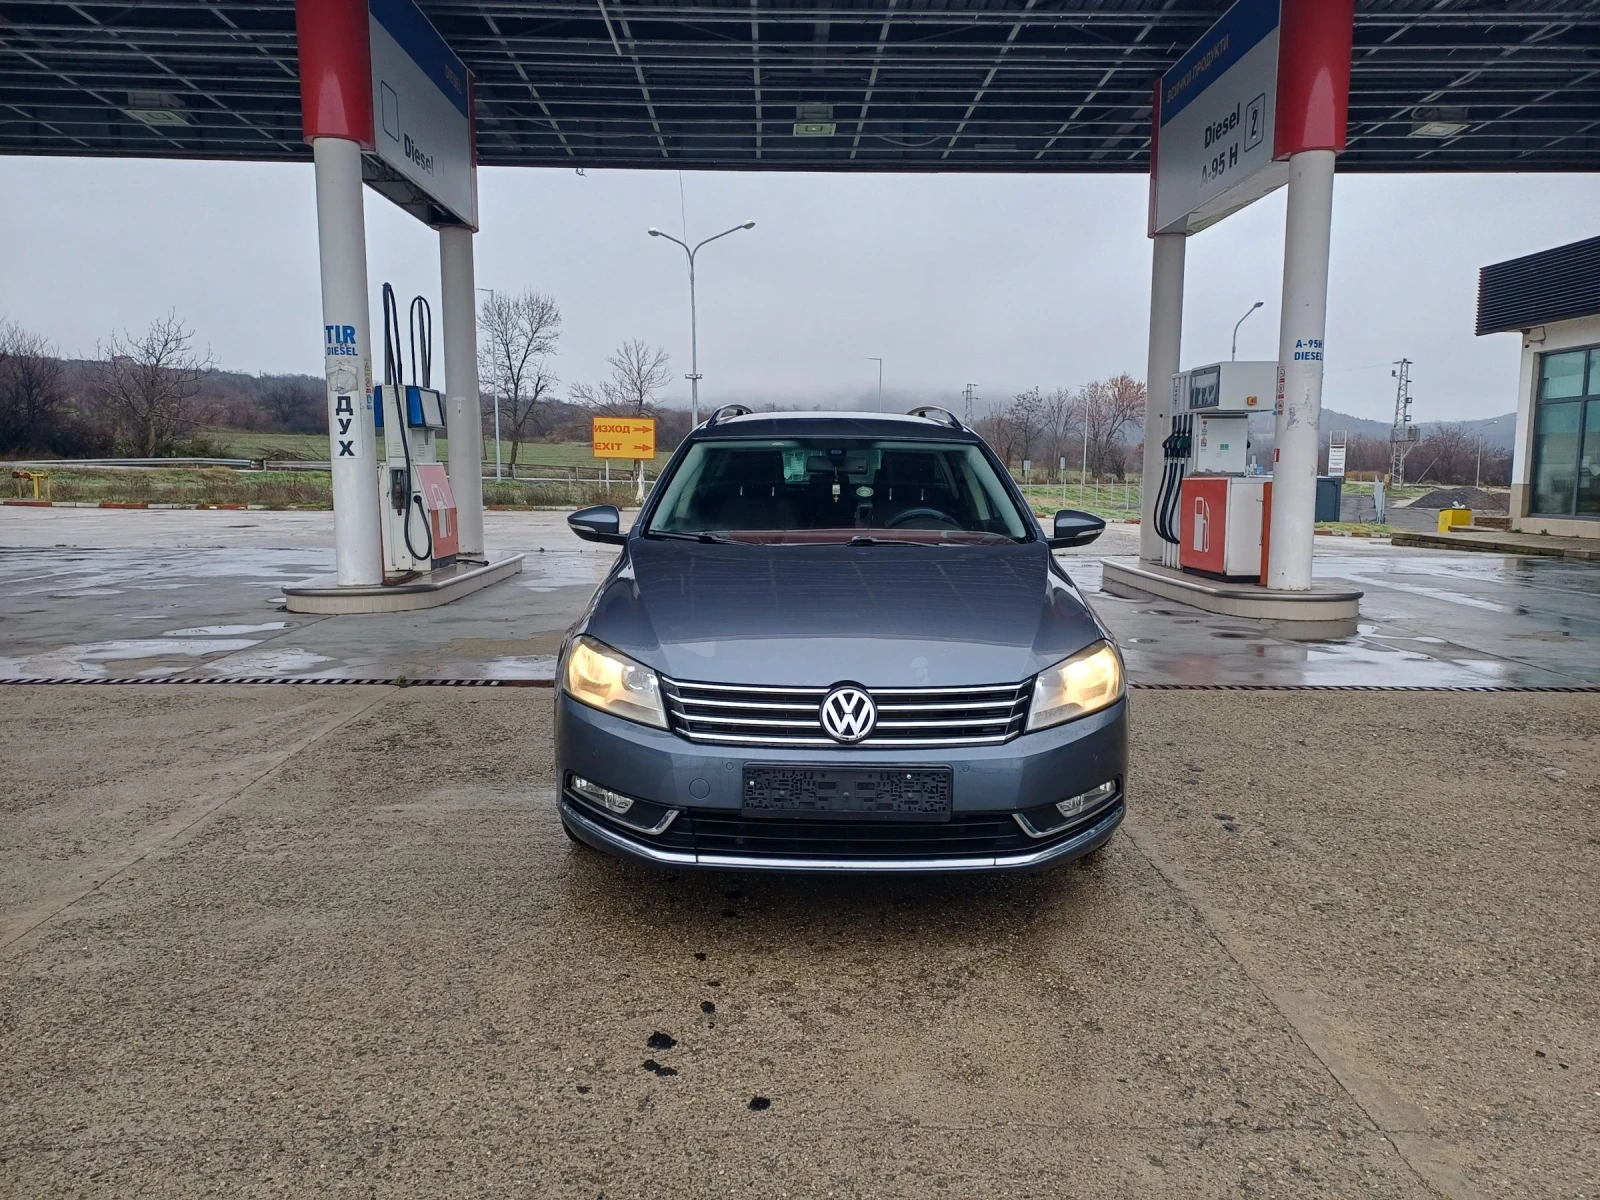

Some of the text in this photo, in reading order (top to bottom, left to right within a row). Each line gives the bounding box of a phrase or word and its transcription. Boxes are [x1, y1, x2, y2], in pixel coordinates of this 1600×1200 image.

[1204, 102, 1241, 149] Diesel
[1251, 109, 1258, 137] 2
[403, 132, 434, 178] Diesel
[325, 325, 356, 344] TIR
[326, 346, 358, 356] DIESEL
[1294, 351, 1323, 361] DIESEL
[594, 424, 631, 434] ИЗХОД
[594, 442, 622, 451] EXIT
[822, 688, 875, 741] VW
